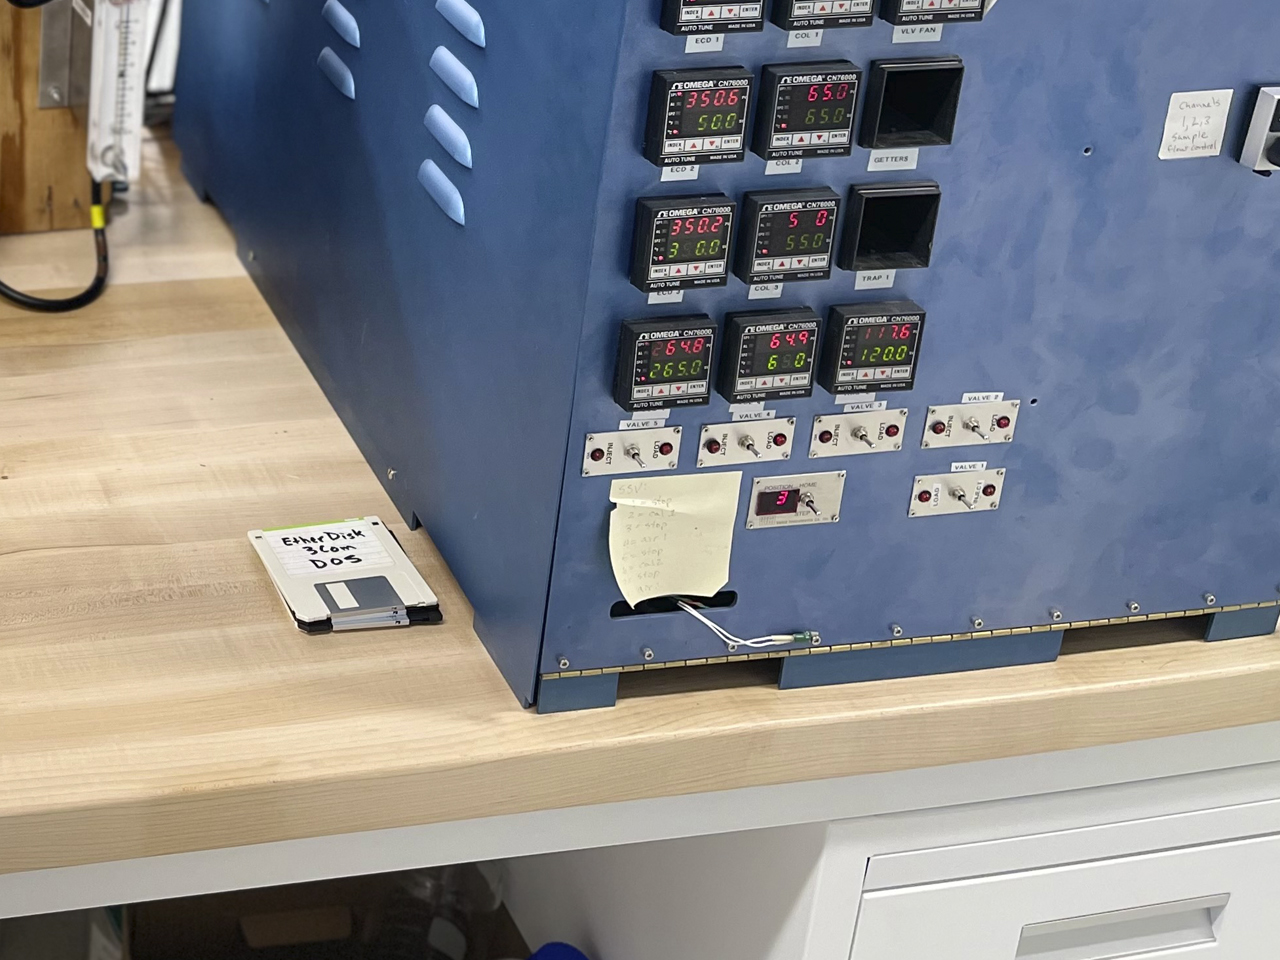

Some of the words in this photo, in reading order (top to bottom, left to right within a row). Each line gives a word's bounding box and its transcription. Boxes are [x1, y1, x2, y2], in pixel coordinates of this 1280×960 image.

[686, 89, 739, 108] 350.6
[807, 83, 849, 102] 65.0
[1179, 96, 1221, 110] Channels
[670, 216, 723, 236] 350.2
[861, 345, 908, 362] 120.0
[649, 359, 702, 379] 265.0
[968, 394, 991, 402] VALVE
[776, 490, 789, 506] 3
[309, 554, 363, 569] DOS
